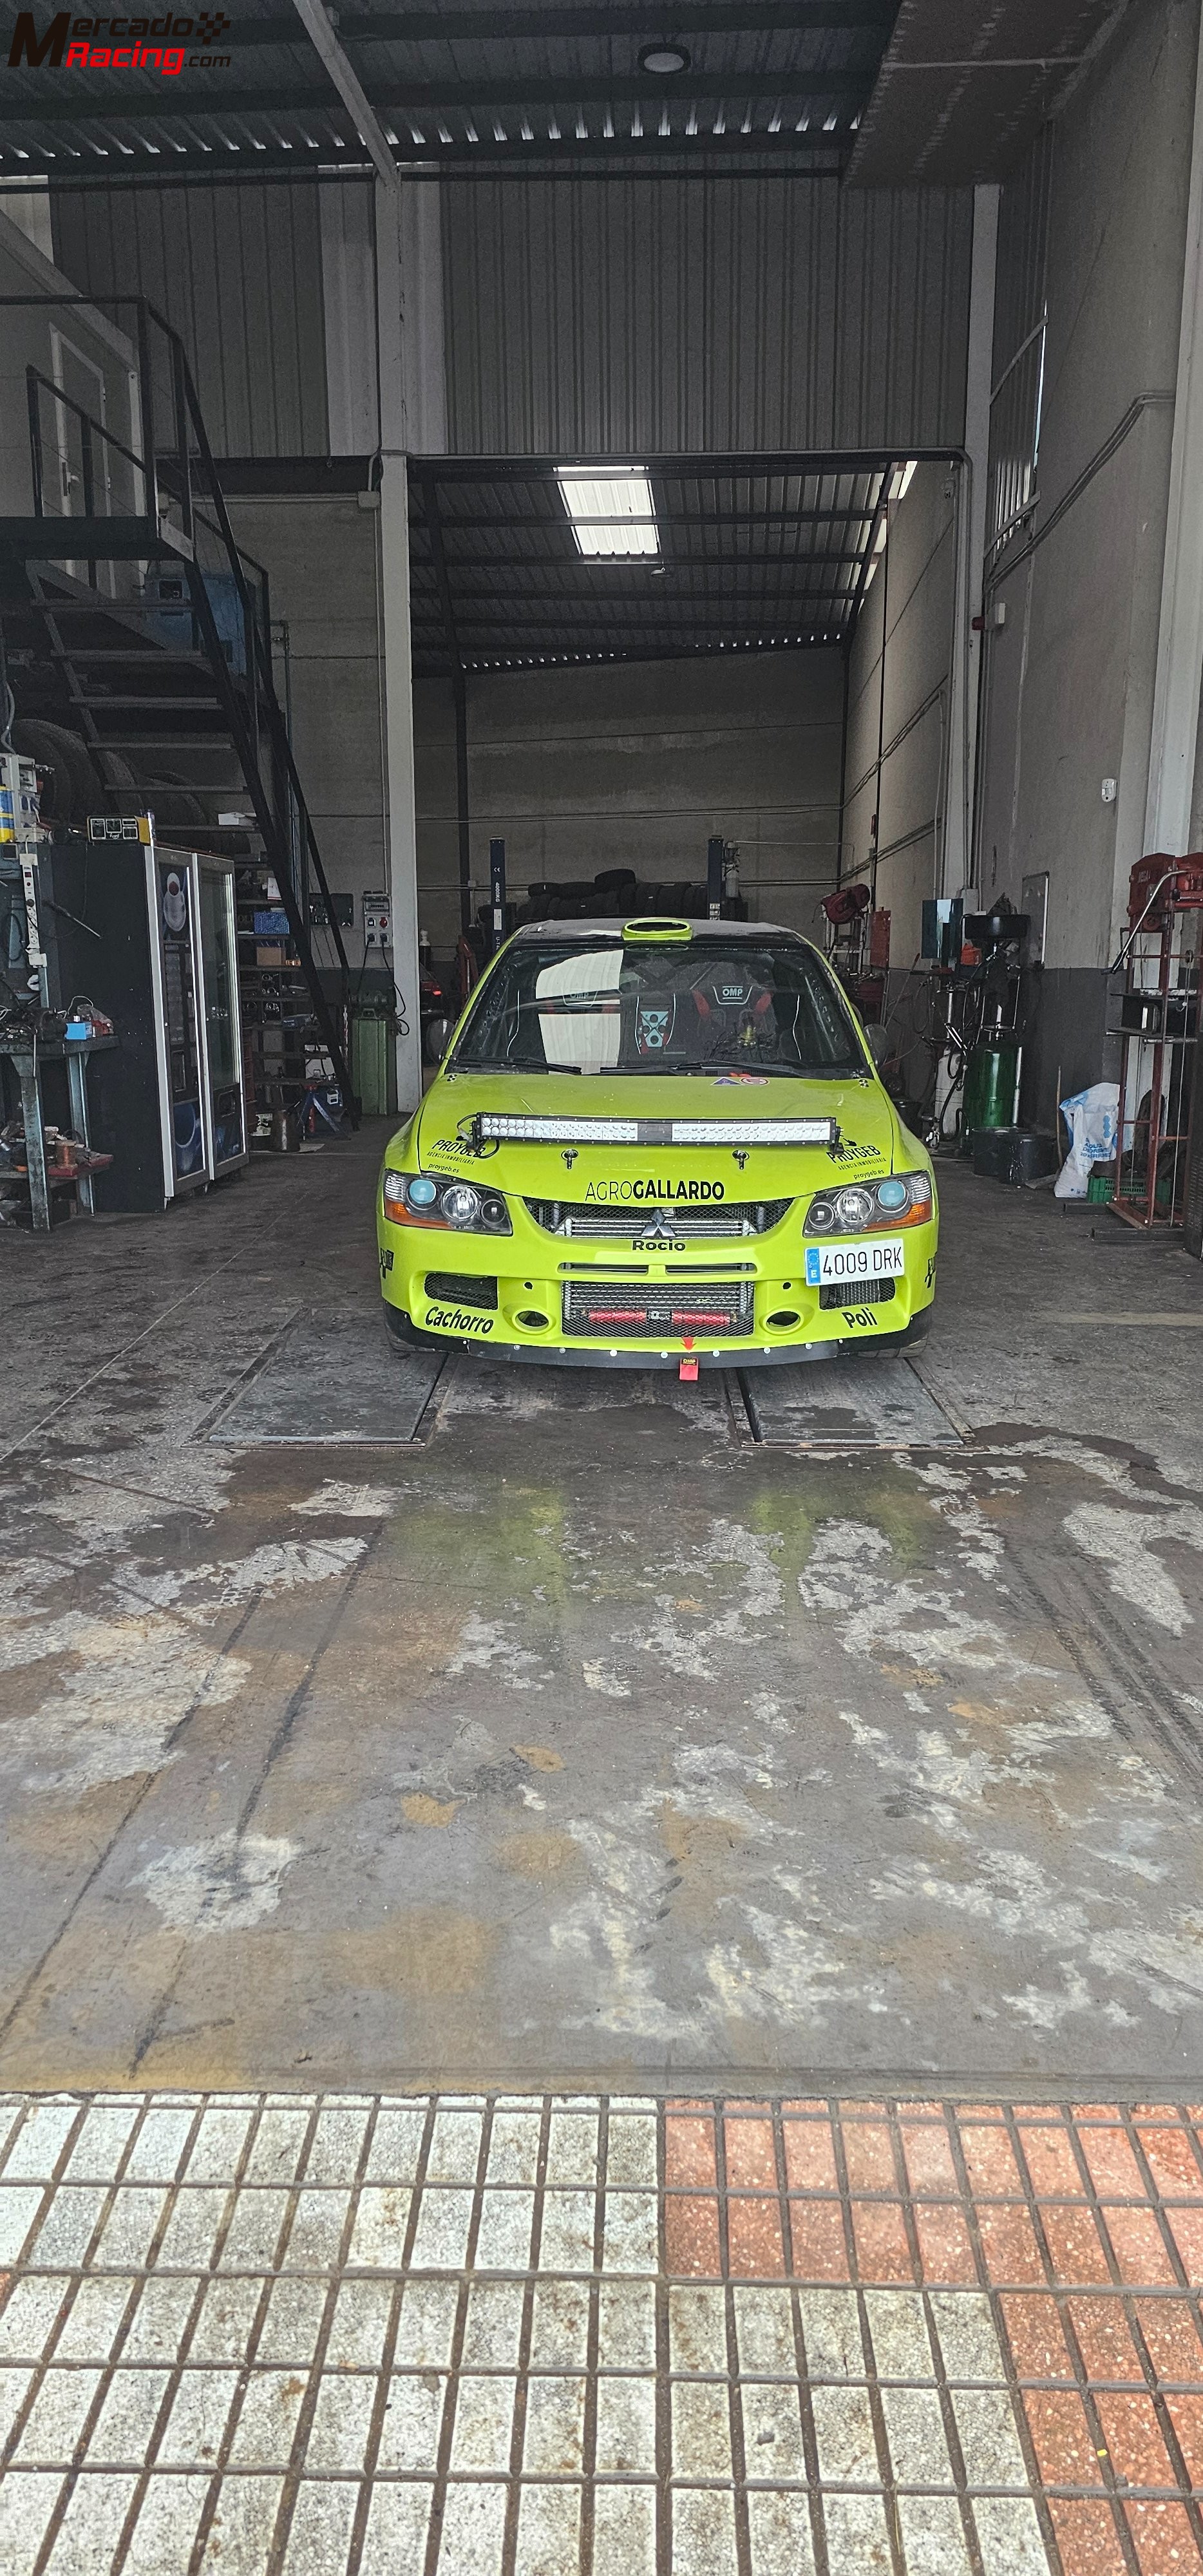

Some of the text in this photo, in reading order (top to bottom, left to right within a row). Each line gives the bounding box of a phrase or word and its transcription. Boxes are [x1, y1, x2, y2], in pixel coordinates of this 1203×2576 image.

[723, 988, 743, 996] OMP
[428, 1163, 460, 1173] proygeb.es
[853, 1170, 884, 1180] proygeb.es
[585, 1179, 725, 1202] AGROGALLARDO
[632, 1238, 686, 1251] Rocio
[811, 1269, 817, 1278] E
[823, 1251, 867, 1276] 4009
[873, 1247, 902, 1271] DRK
[425, 1306, 494, 1334] Cachorro
[841, 1307, 878, 1329] Poli
